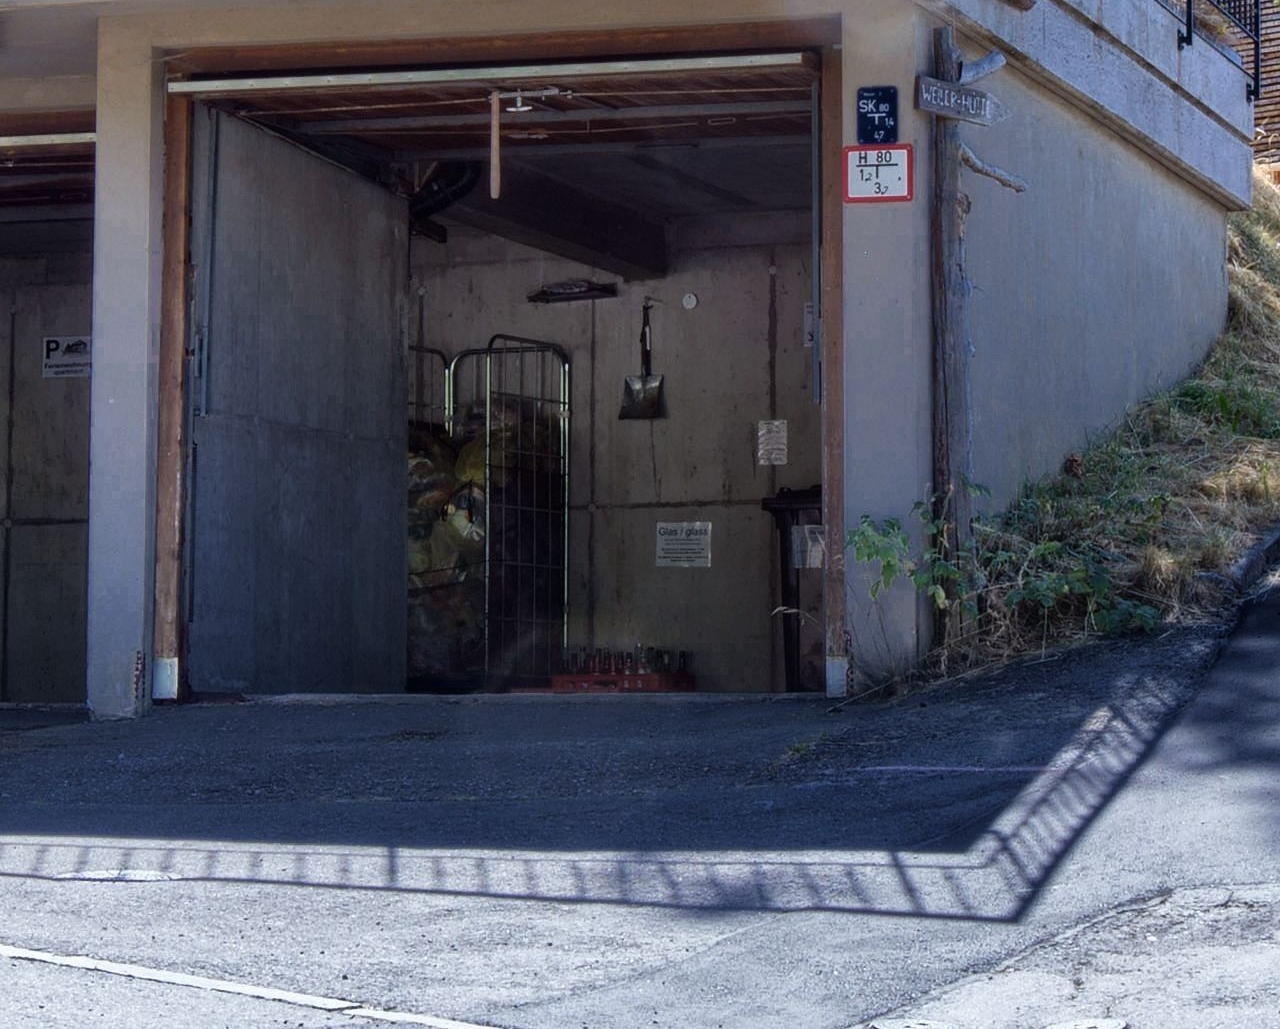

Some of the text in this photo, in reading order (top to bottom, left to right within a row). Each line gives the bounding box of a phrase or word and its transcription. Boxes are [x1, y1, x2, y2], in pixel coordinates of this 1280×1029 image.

[859, 99, 890, 112] SK 80
[858, 151, 892, 164] H 80
[45, 339, 60, 359] P
[658, 527, 678, 536] Glas
[685, 526, 708, 538] glass
